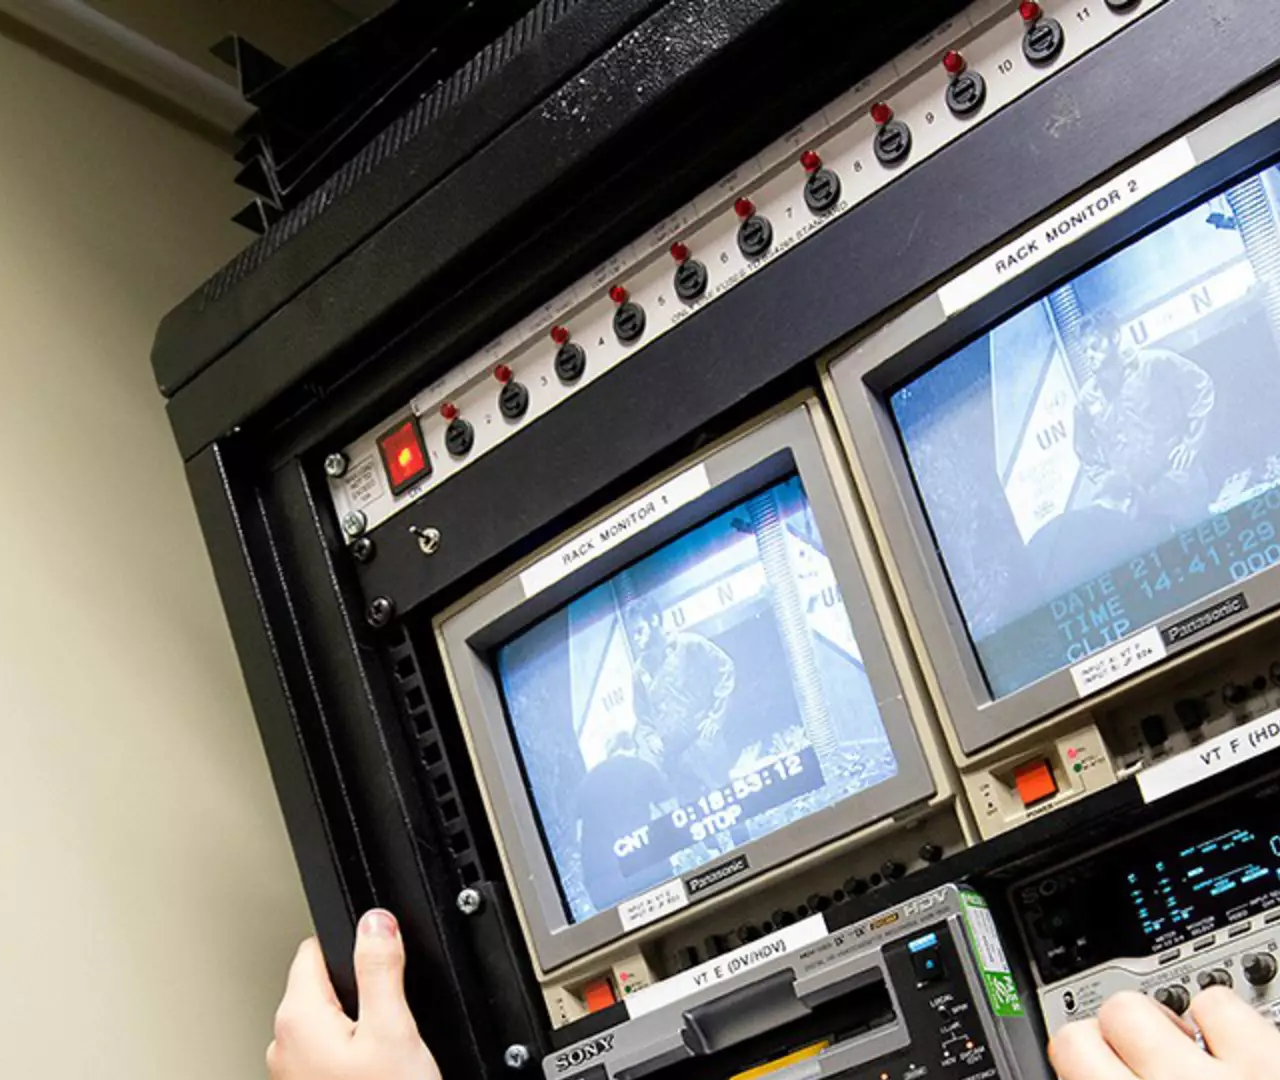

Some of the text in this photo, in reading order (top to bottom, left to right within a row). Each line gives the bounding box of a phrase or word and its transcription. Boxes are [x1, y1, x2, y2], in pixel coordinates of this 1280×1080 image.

[1075, 6, 1091, 23] 11
[997, 59, 1014, 75] 10
[925, 112, 935, 125] 9
[853, 160, 863, 173] 8
[785, 206, 794, 219] 7
[995, 179, 1140, 275] RACK MONITOR 2
[720, 252, 729, 264] 6
[597, 337, 606, 346] 4
[540, 376, 549, 387] 3
[1036, 420, 1067, 451] UN
[563, 495, 669, 566] RACK MONITOR 1
[1050, 574, 1116, 620] DATE
[1132, 550, 1163, 581] 21
[1179, 514, 1231, 555] FEB
[1058, 526, 1276, 642] TIME 14:41:29
[1168, 598, 1242, 642] Panasonic
[1066, 618, 1131, 665] CLIP
[1199, 747, 1223, 769] VT
[1230, 740, 1242, 756] F
[672, 753, 805, 829] 0:18:53:12
[689, 805, 743, 842] STOP
[613, 828, 651, 858] CNT
[689, 860, 745, 891] Panasonic
[903, 888, 949, 918] HDV
[694, 937, 789, 989] VT E (DV/HDV)
[555, 1033, 615, 1073] SONY
